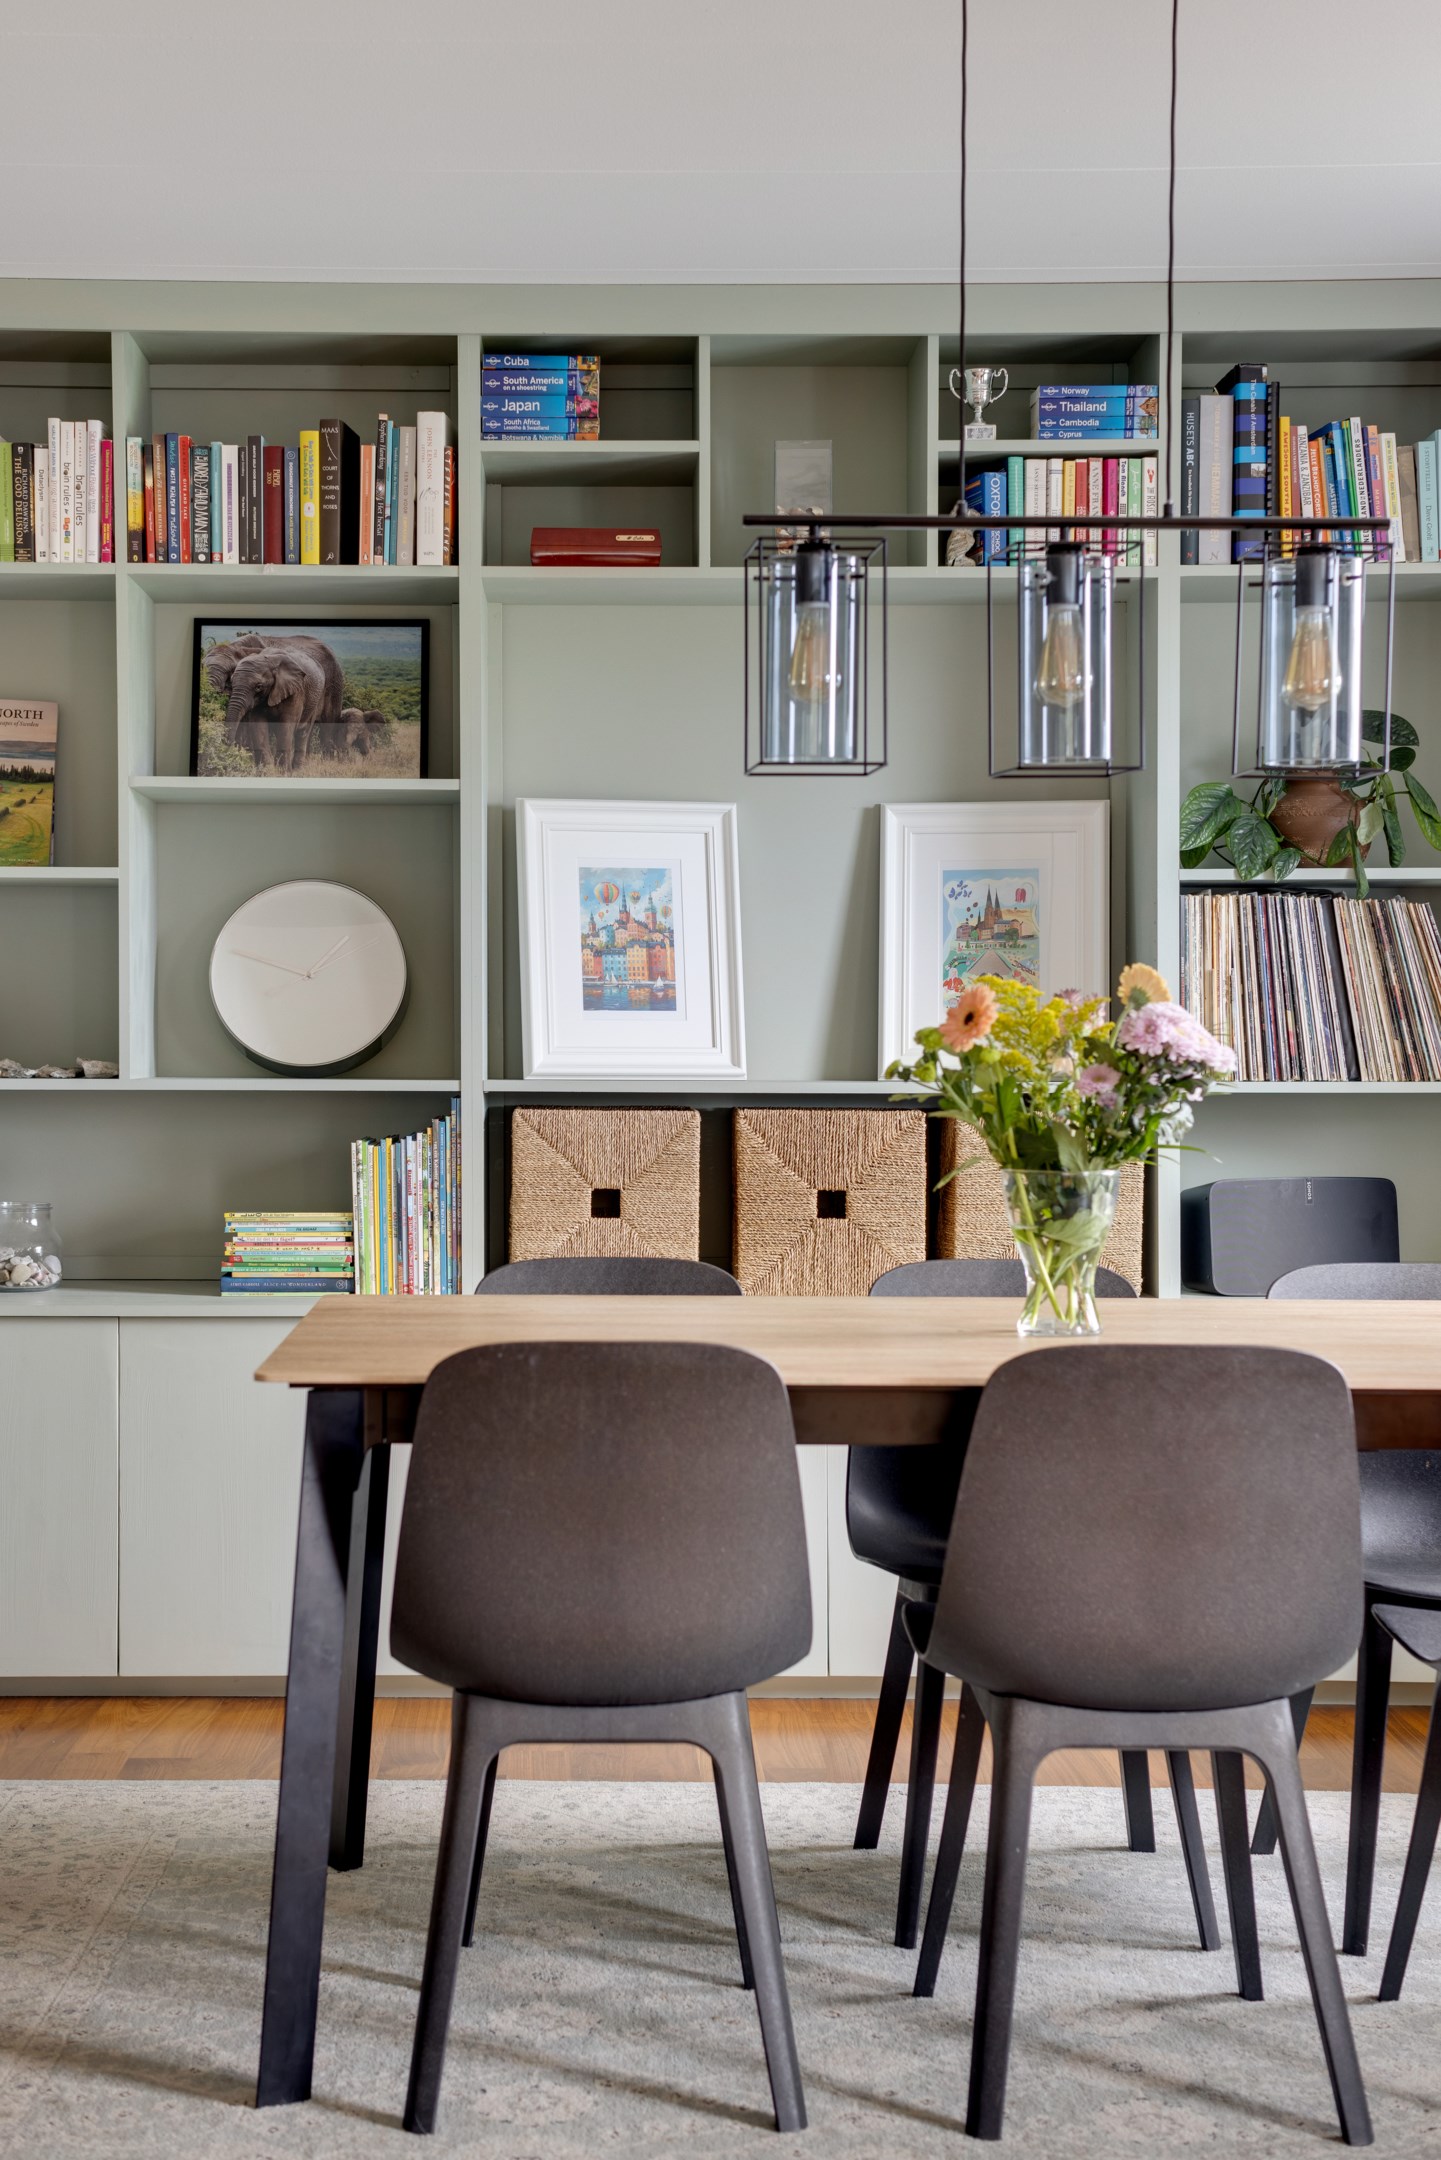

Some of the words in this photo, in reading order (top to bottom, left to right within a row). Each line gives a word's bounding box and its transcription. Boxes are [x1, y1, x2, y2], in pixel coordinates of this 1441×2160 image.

[503, 356, 530, 366] Cuba
[503, 376, 528, 385] South
[530, 376, 564, 385] America
[1061, 387, 1090, 395] Norway
[501, 399, 540, 414] Japan
[1060, 402, 1107, 412] Thailand
[1298, 433, 1307, 465] TANZANIA
[1355, 439, 1366, 495] NEDERLANDERS
[991, 478, 1001, 518] OXFOR
[1210, 463, 1220, 542] HEMMAFIXEN
[1302, 474, 1311, 506] ZANZIBAR
[1329, 483, 1337, 519] AMSTERDA
[15, 500, 23, 544] DELUSION
[76, 502, 85, 526] rules
[1147, 516, 1155, 538] PECT
